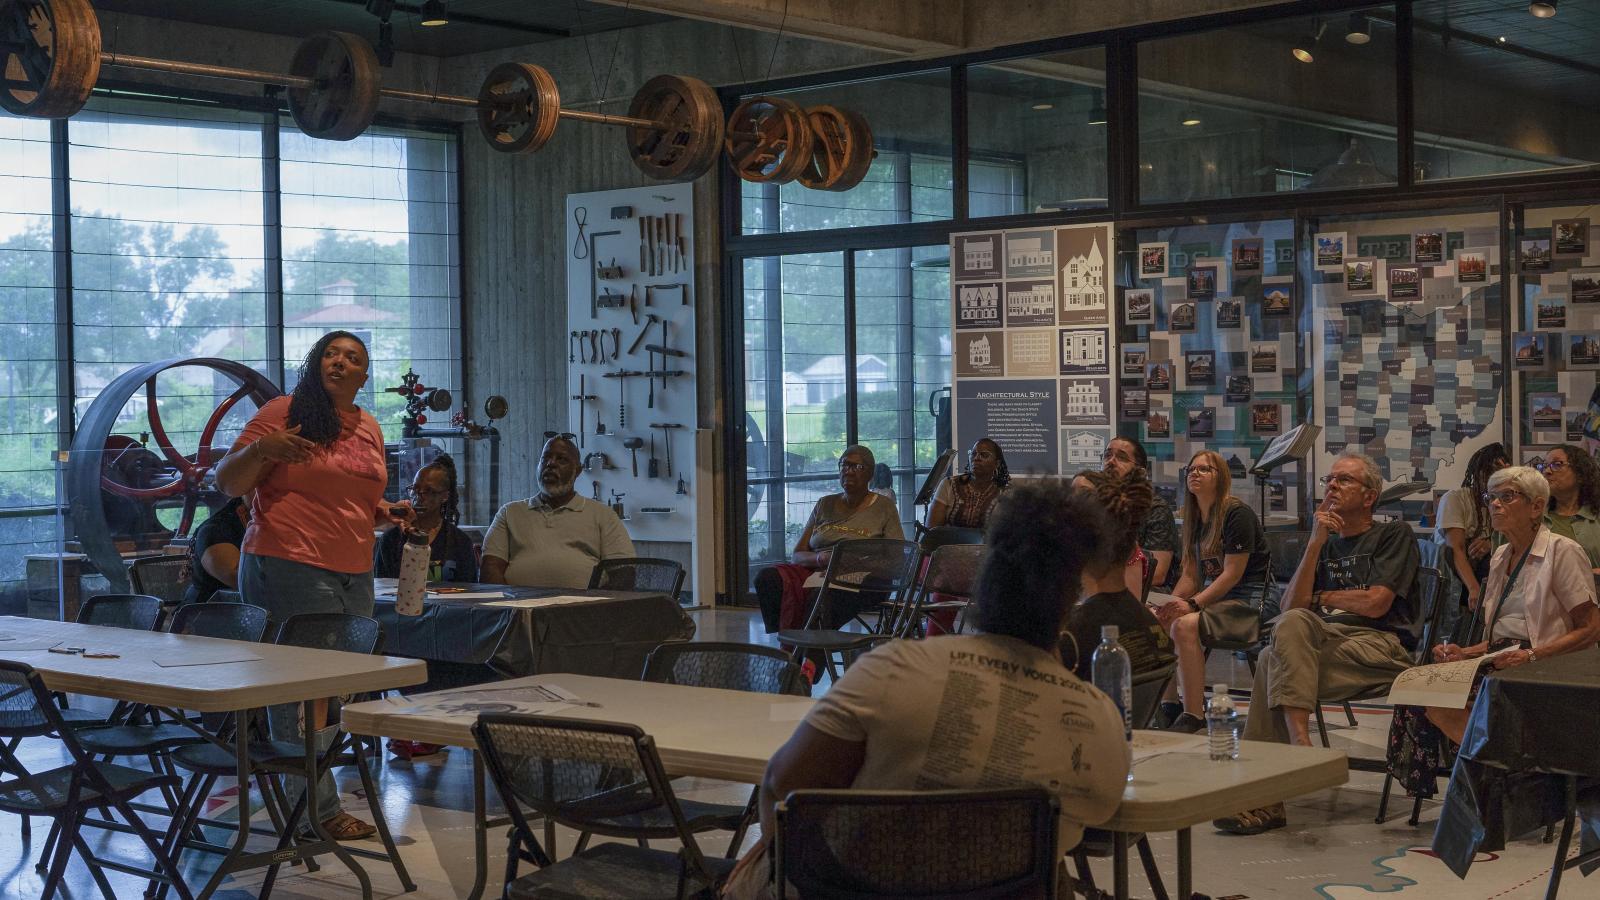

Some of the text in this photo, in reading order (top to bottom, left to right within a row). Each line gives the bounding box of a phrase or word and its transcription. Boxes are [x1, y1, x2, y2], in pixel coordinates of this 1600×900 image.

[950, 650, 975, 662] LIFT
[978, 654, 1021, 674] EVERY
[1022, 665, 1058, 684] VOICE
